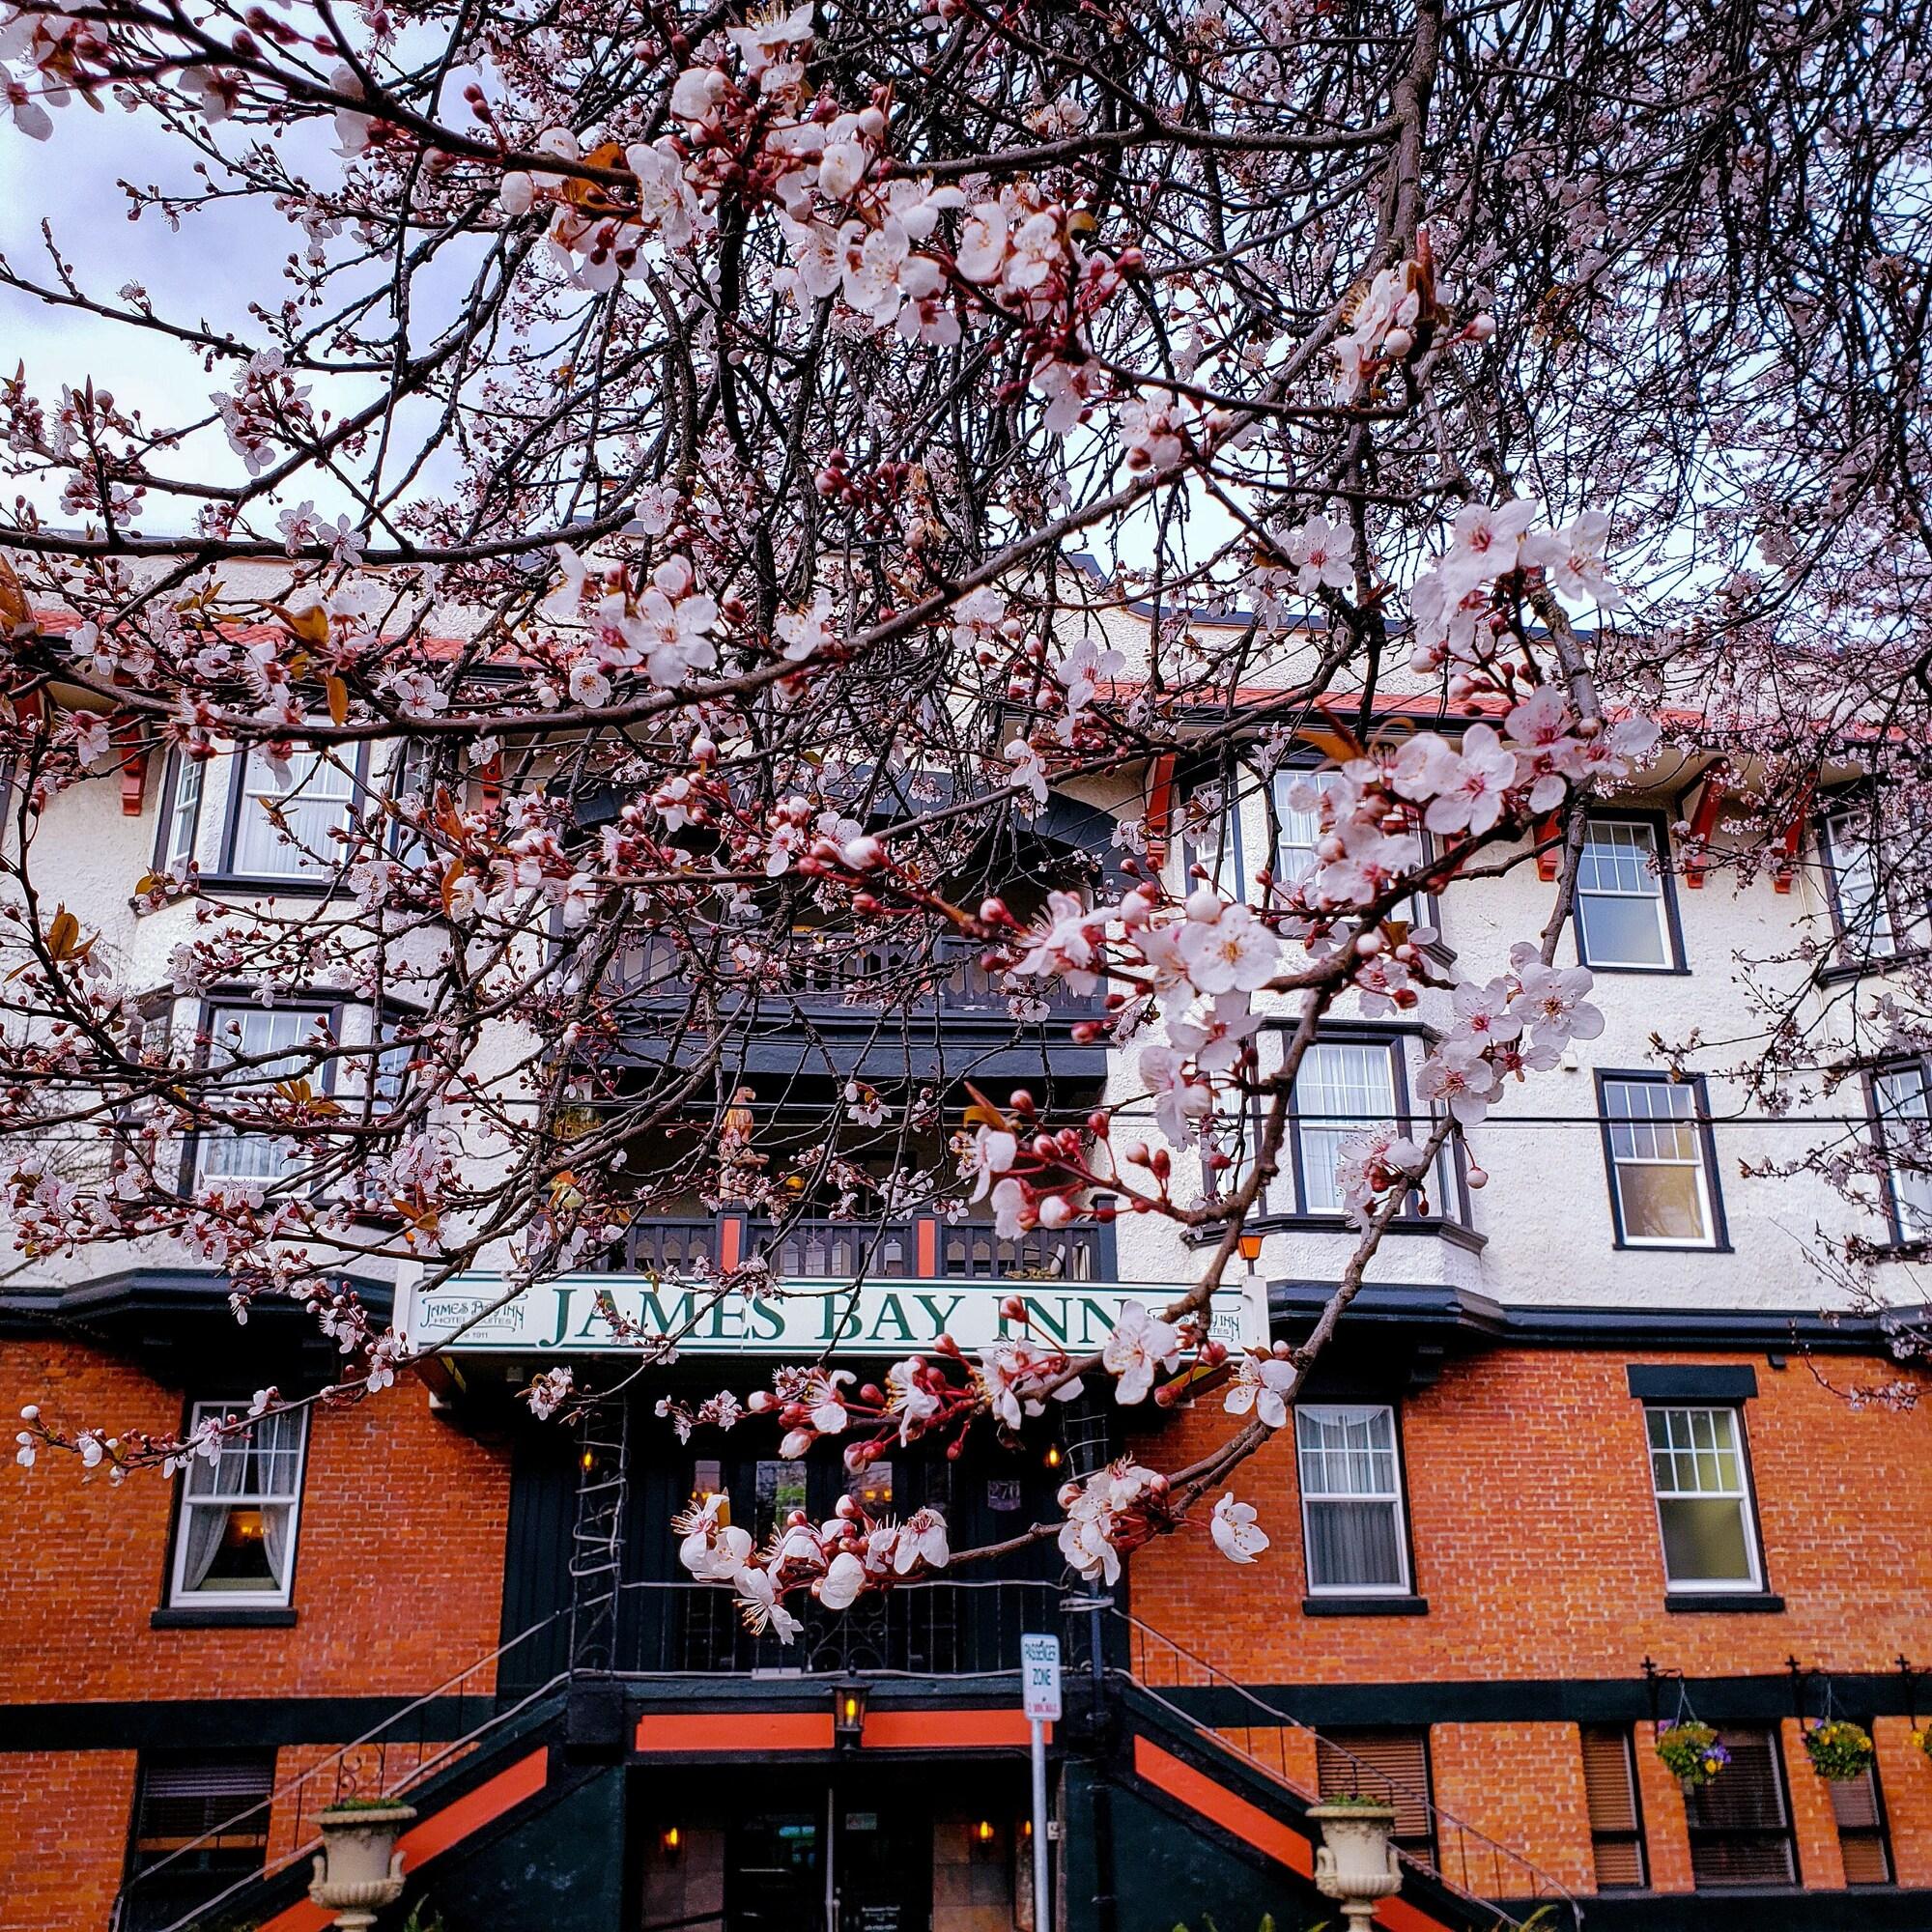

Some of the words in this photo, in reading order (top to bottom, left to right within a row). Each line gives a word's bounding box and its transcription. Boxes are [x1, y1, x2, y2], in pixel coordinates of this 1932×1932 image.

[419, 1302, 469, 1328] JAMES
[503, 1304, 525, 1330] INN
[538, 1288, 786, 1348] JAMES
[813, 1292, 967, 1341] BAY
[991, 1294, 1132, 1344] INN
[1033, 1667, 1052, 1686] ZONE
